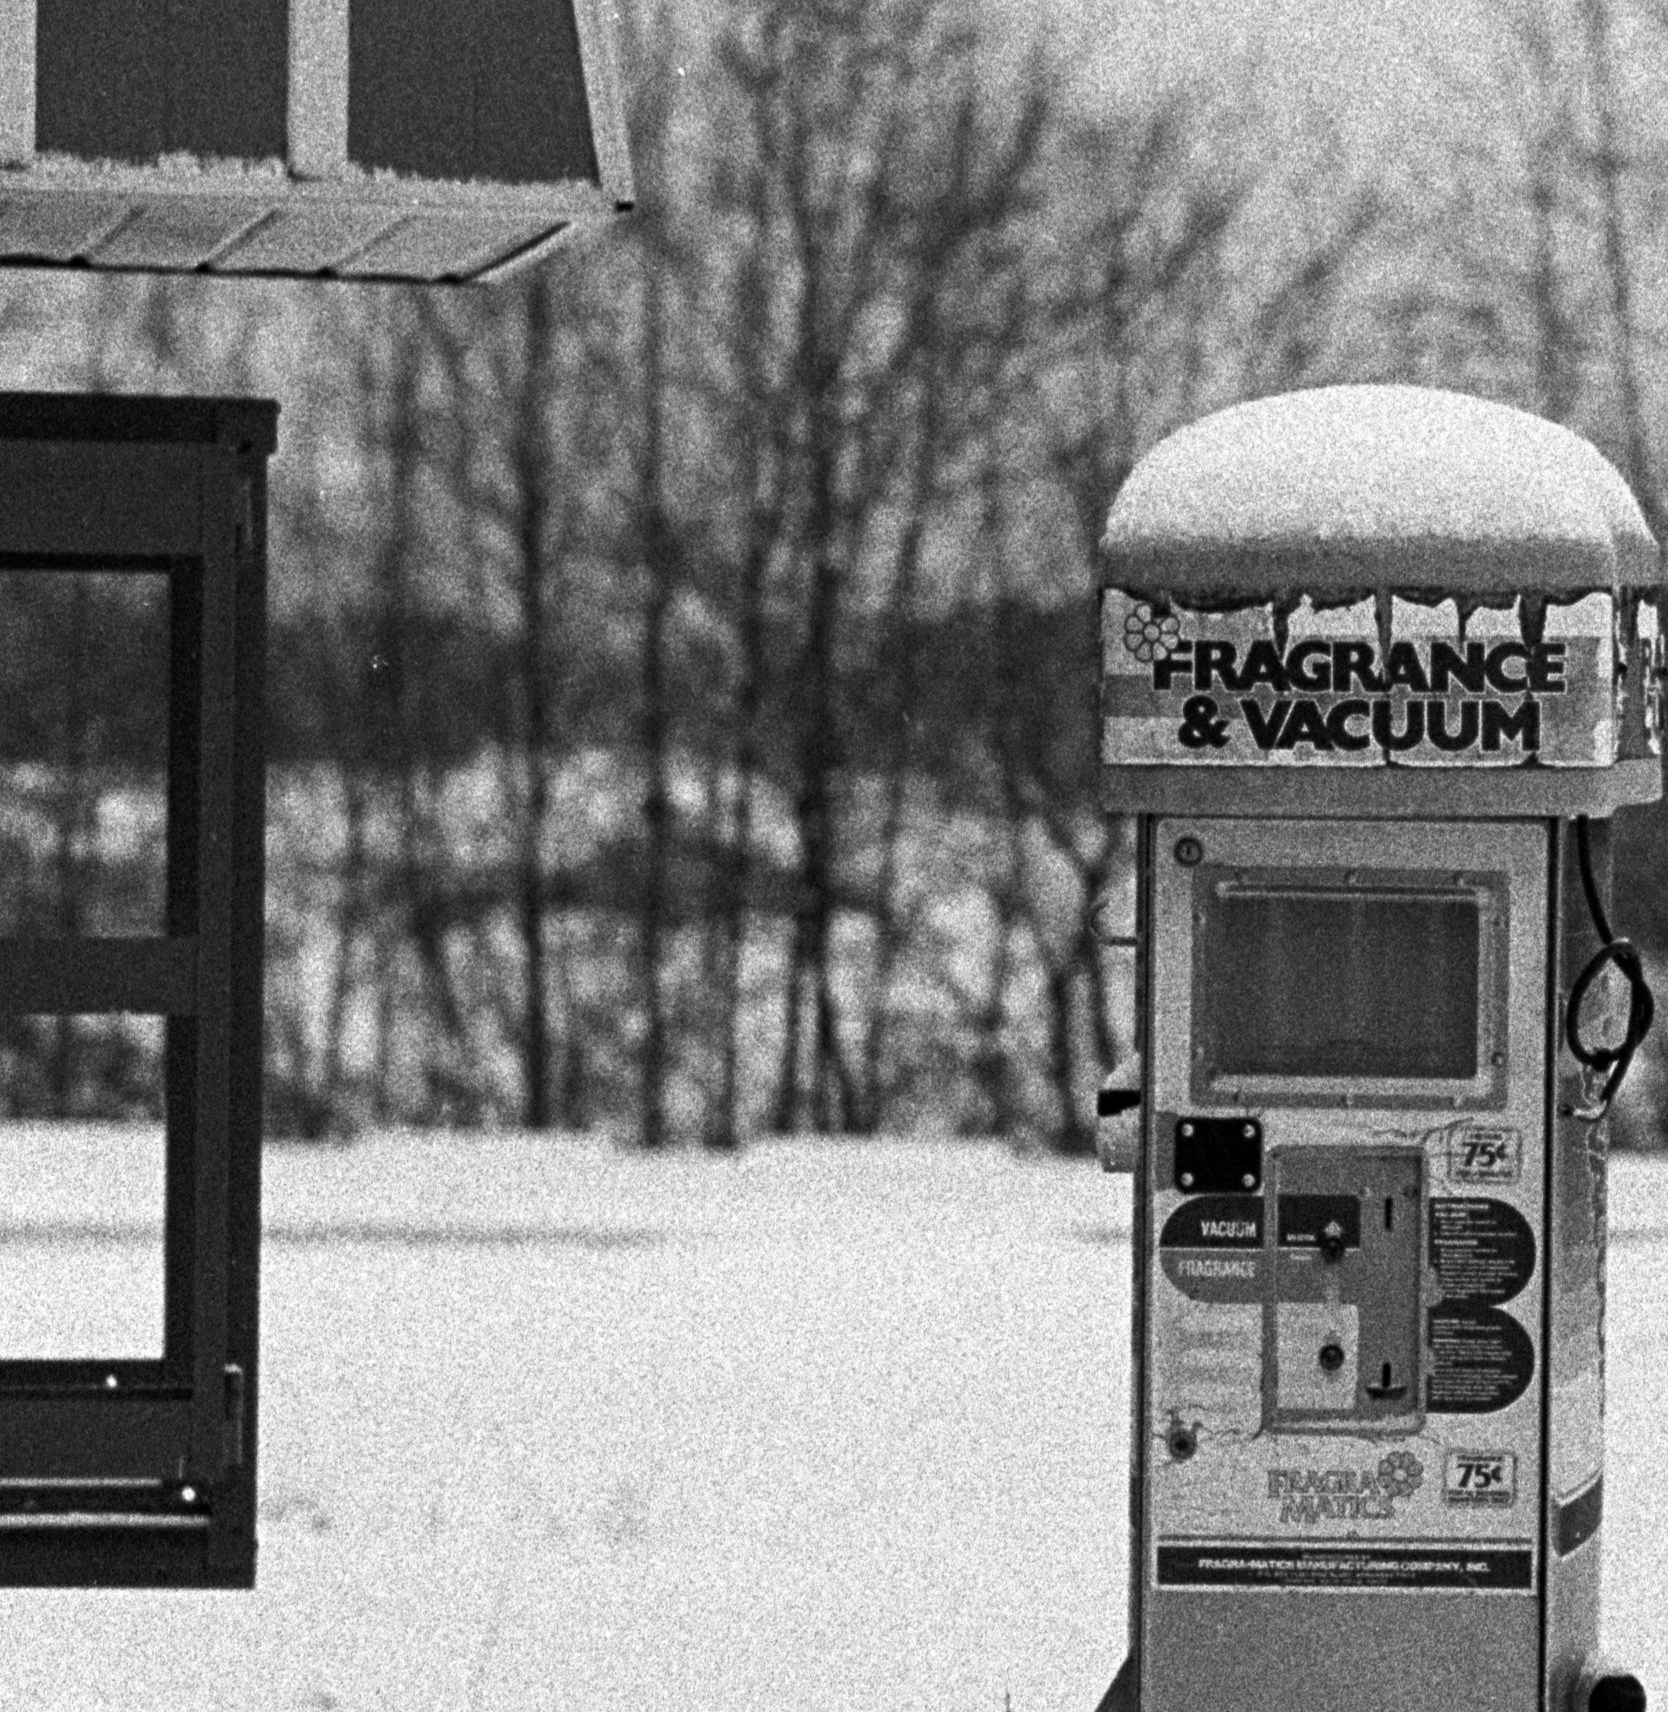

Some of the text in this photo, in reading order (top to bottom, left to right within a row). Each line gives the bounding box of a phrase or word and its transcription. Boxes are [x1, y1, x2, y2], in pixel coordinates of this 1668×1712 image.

[1153, 640, 1567, 694] FRAGRANCE
[1177, 695, 1541, 752] & VACUUM
[1201, 1220, 1257, 1238] VACUUM
[1178, 1260, 1256, 1278] FRAGRANCE
[1457, 1462, 1503, 1488] 75¢
